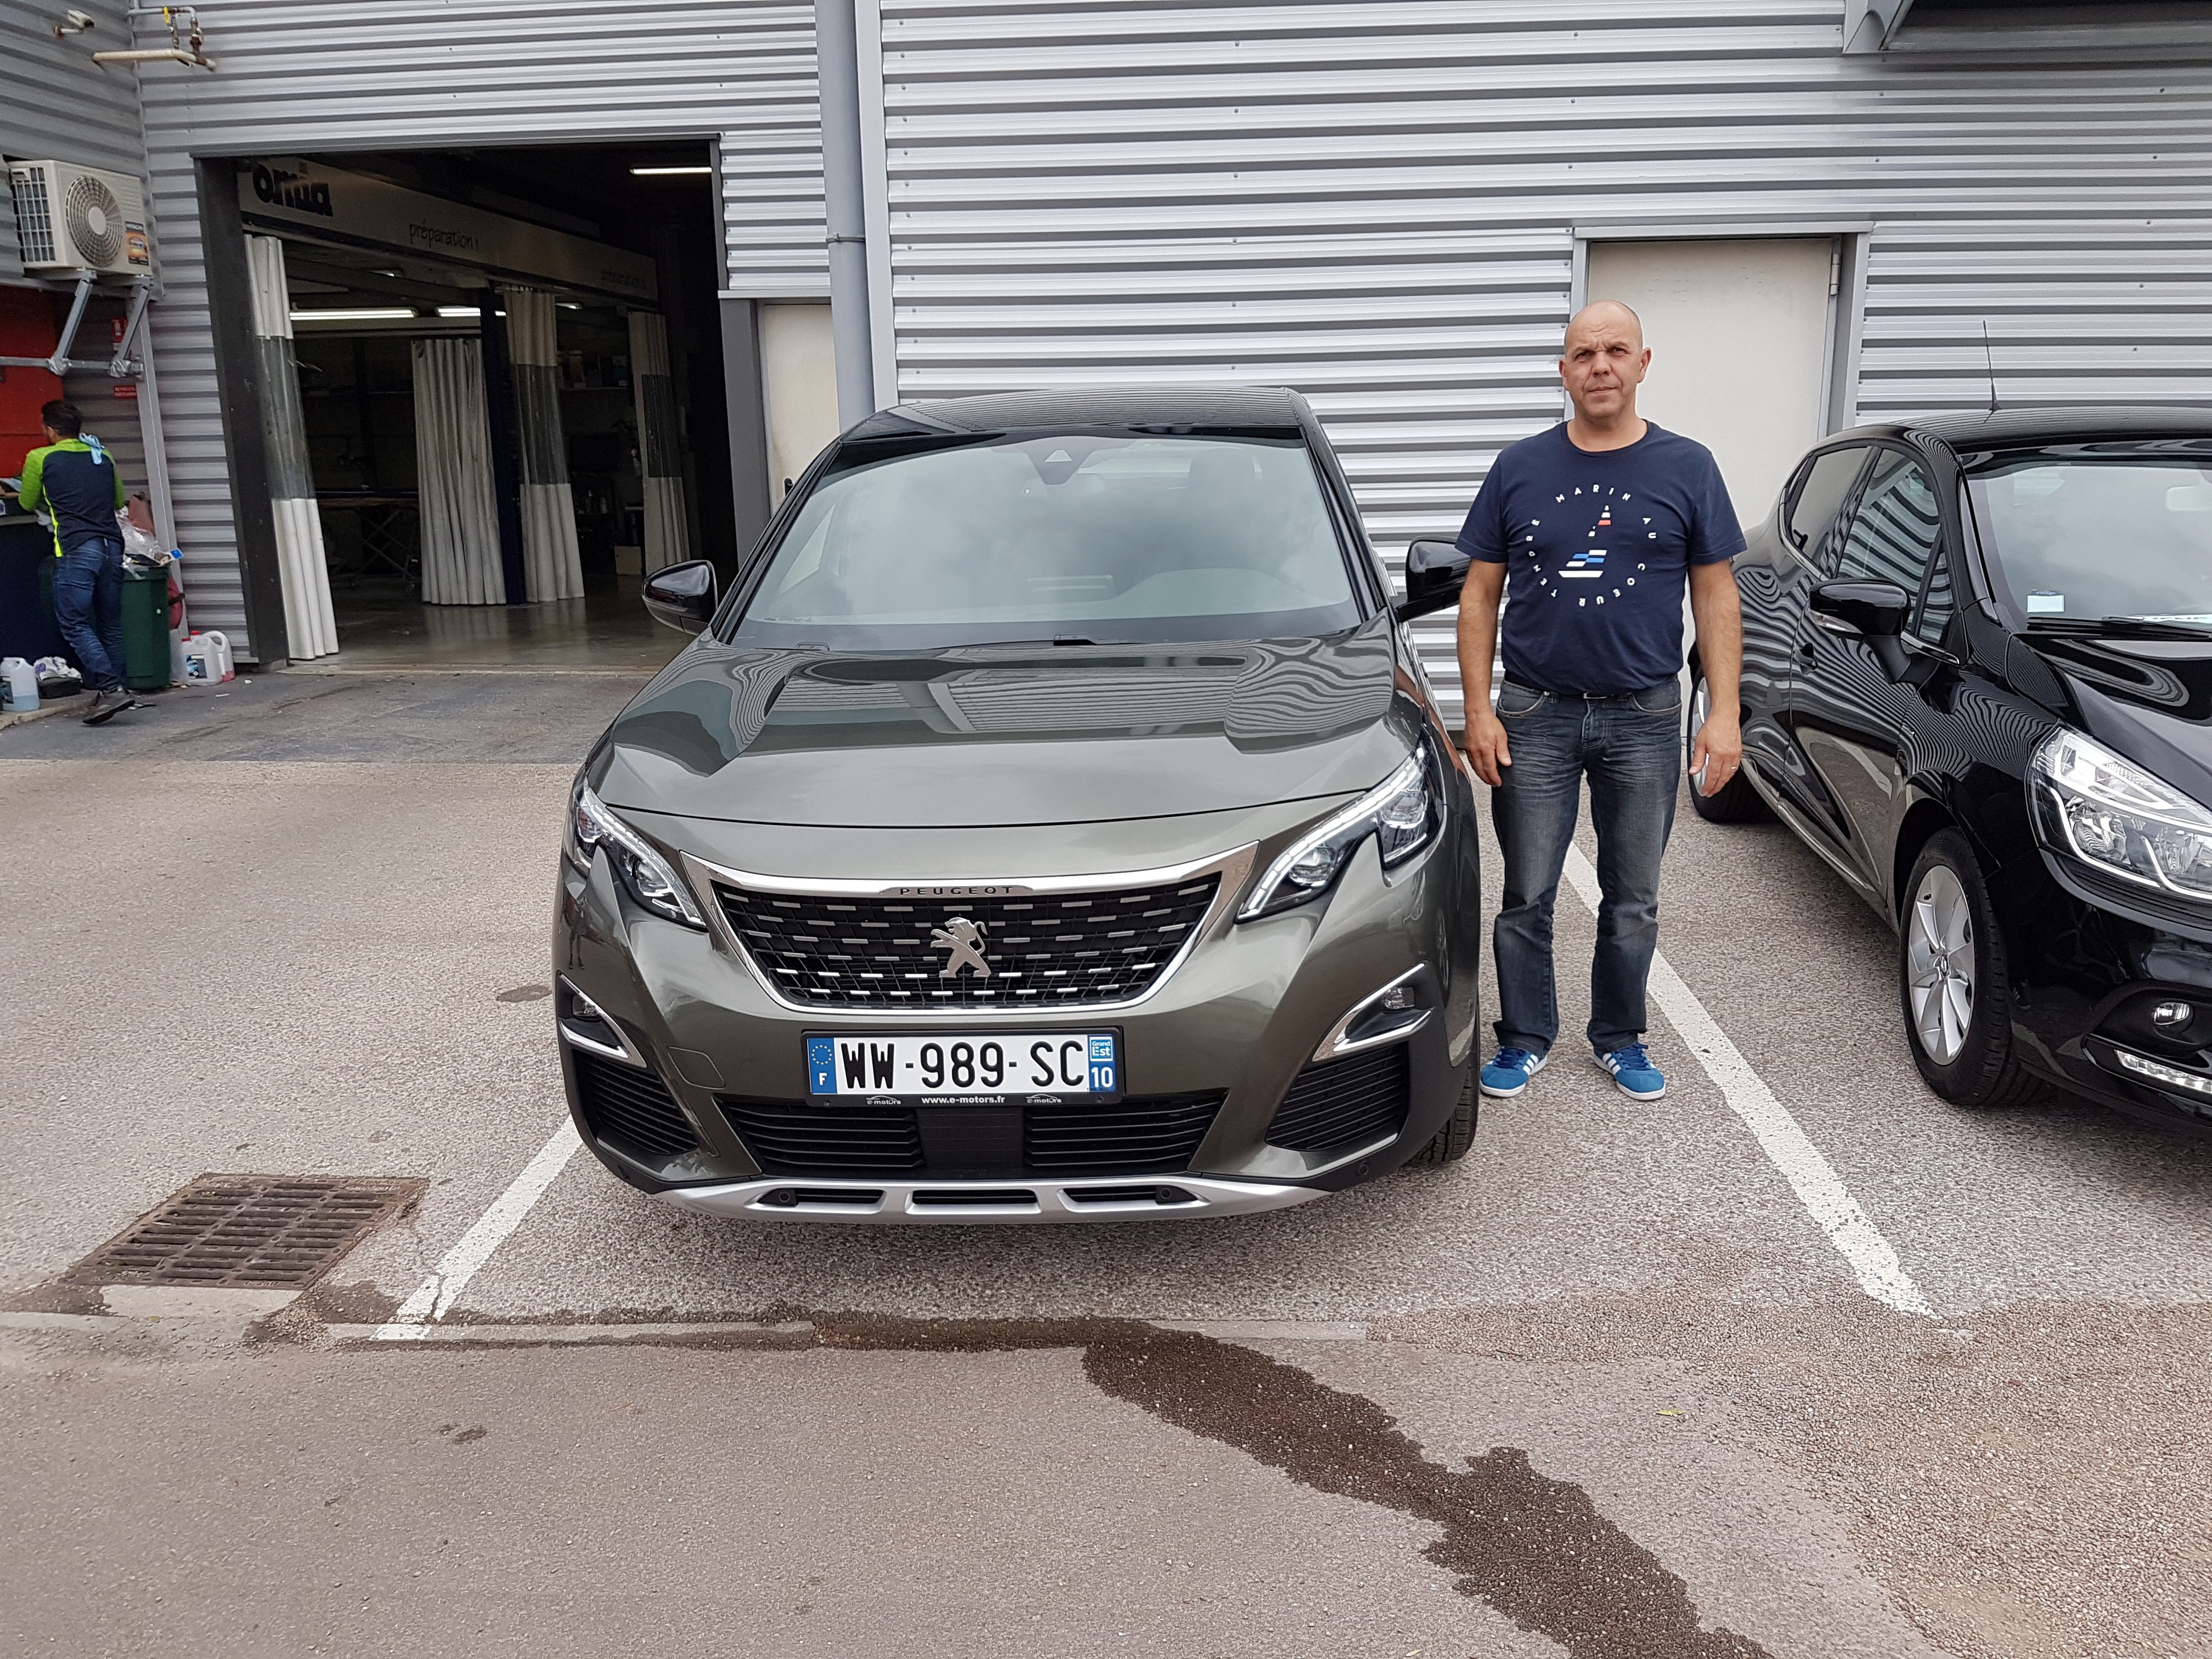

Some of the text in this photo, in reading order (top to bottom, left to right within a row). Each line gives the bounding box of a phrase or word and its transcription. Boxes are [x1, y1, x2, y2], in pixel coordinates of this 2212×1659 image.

[409, 219, 473, 250] préparation
[1555, 484, 1631, 503] MARIN
[1643, 517, 1657, 539] AU
[900, 886, 1013, 895] PEUGEOT
[1092, 1046, 1110, 1056] Est
[819, 1073, 827, 1085] F
[1091, 1066, 1113, 1087] 10
[921, 1096, 1006, 1104] www.e-motors.fr
